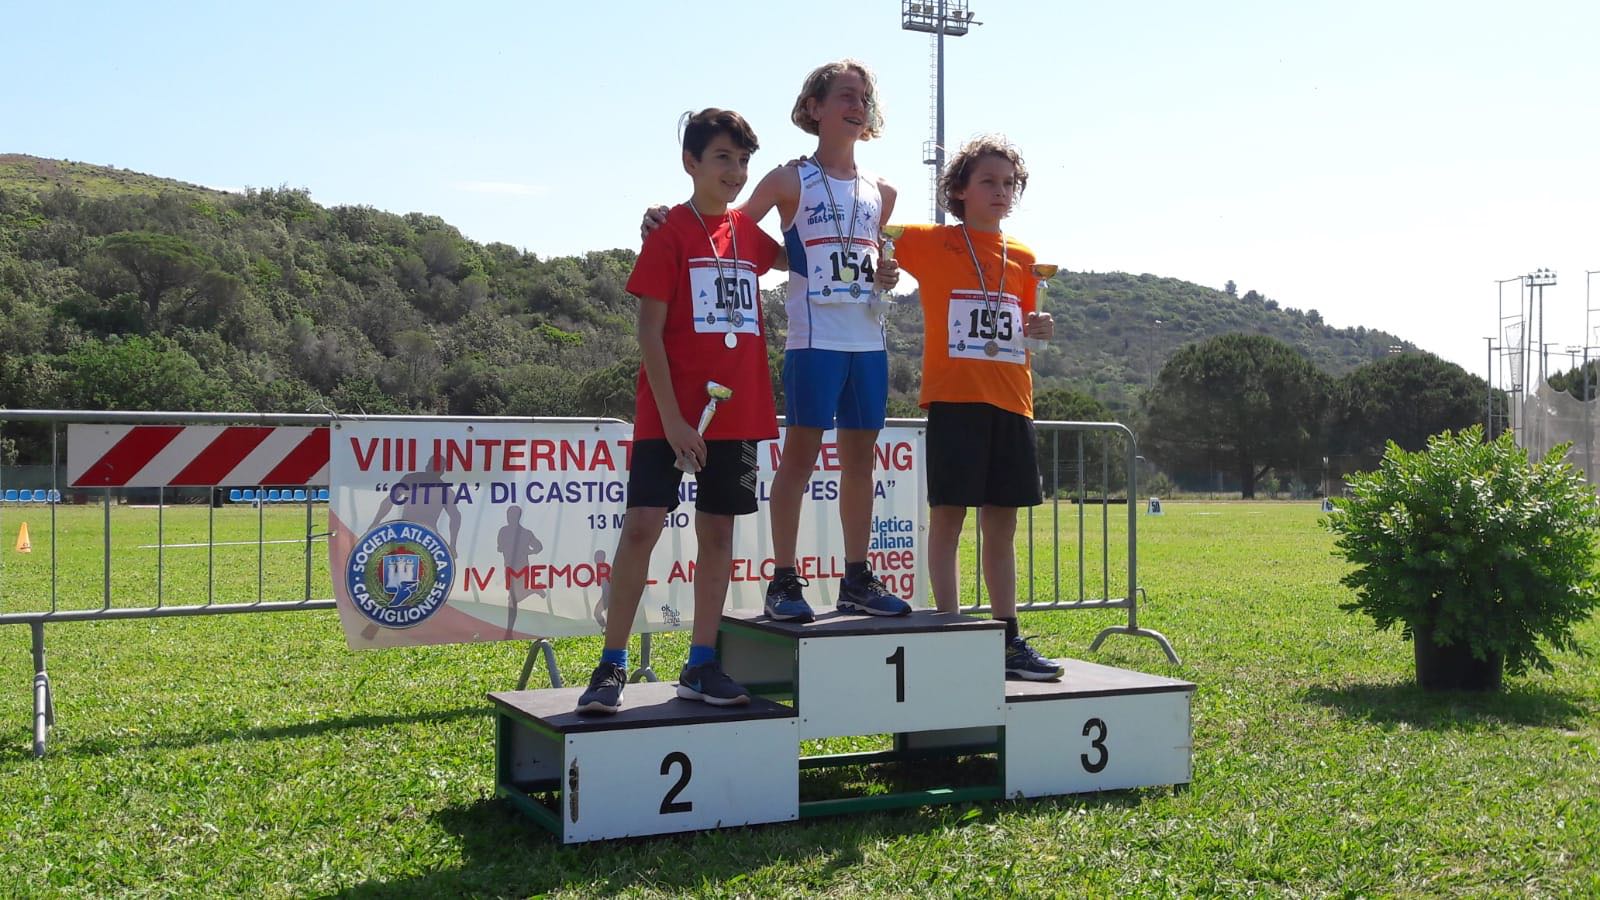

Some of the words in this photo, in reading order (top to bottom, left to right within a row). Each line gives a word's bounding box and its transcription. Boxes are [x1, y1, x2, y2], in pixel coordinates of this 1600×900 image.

[830, 252, 875, 283] 154
[714, 277, 753, 310] 150
[350, 437, 417, 472] VIII
[490, 481, 517, 504] DI
[587, 513, 608, 530] 13
[352, 524, 398, 573] SOCIETÀ
[400, 526, 449, 571] ATLETICA
[869, 532, 914, 550] aliana
[463, 566, 496, 592] IV
[353, 580, 446, 623] CASTIGLIONESE
[885, 645, 906, 704] 1
[1079, 717, 1109, 774] 3
[658, 751, 693, 815] 2
